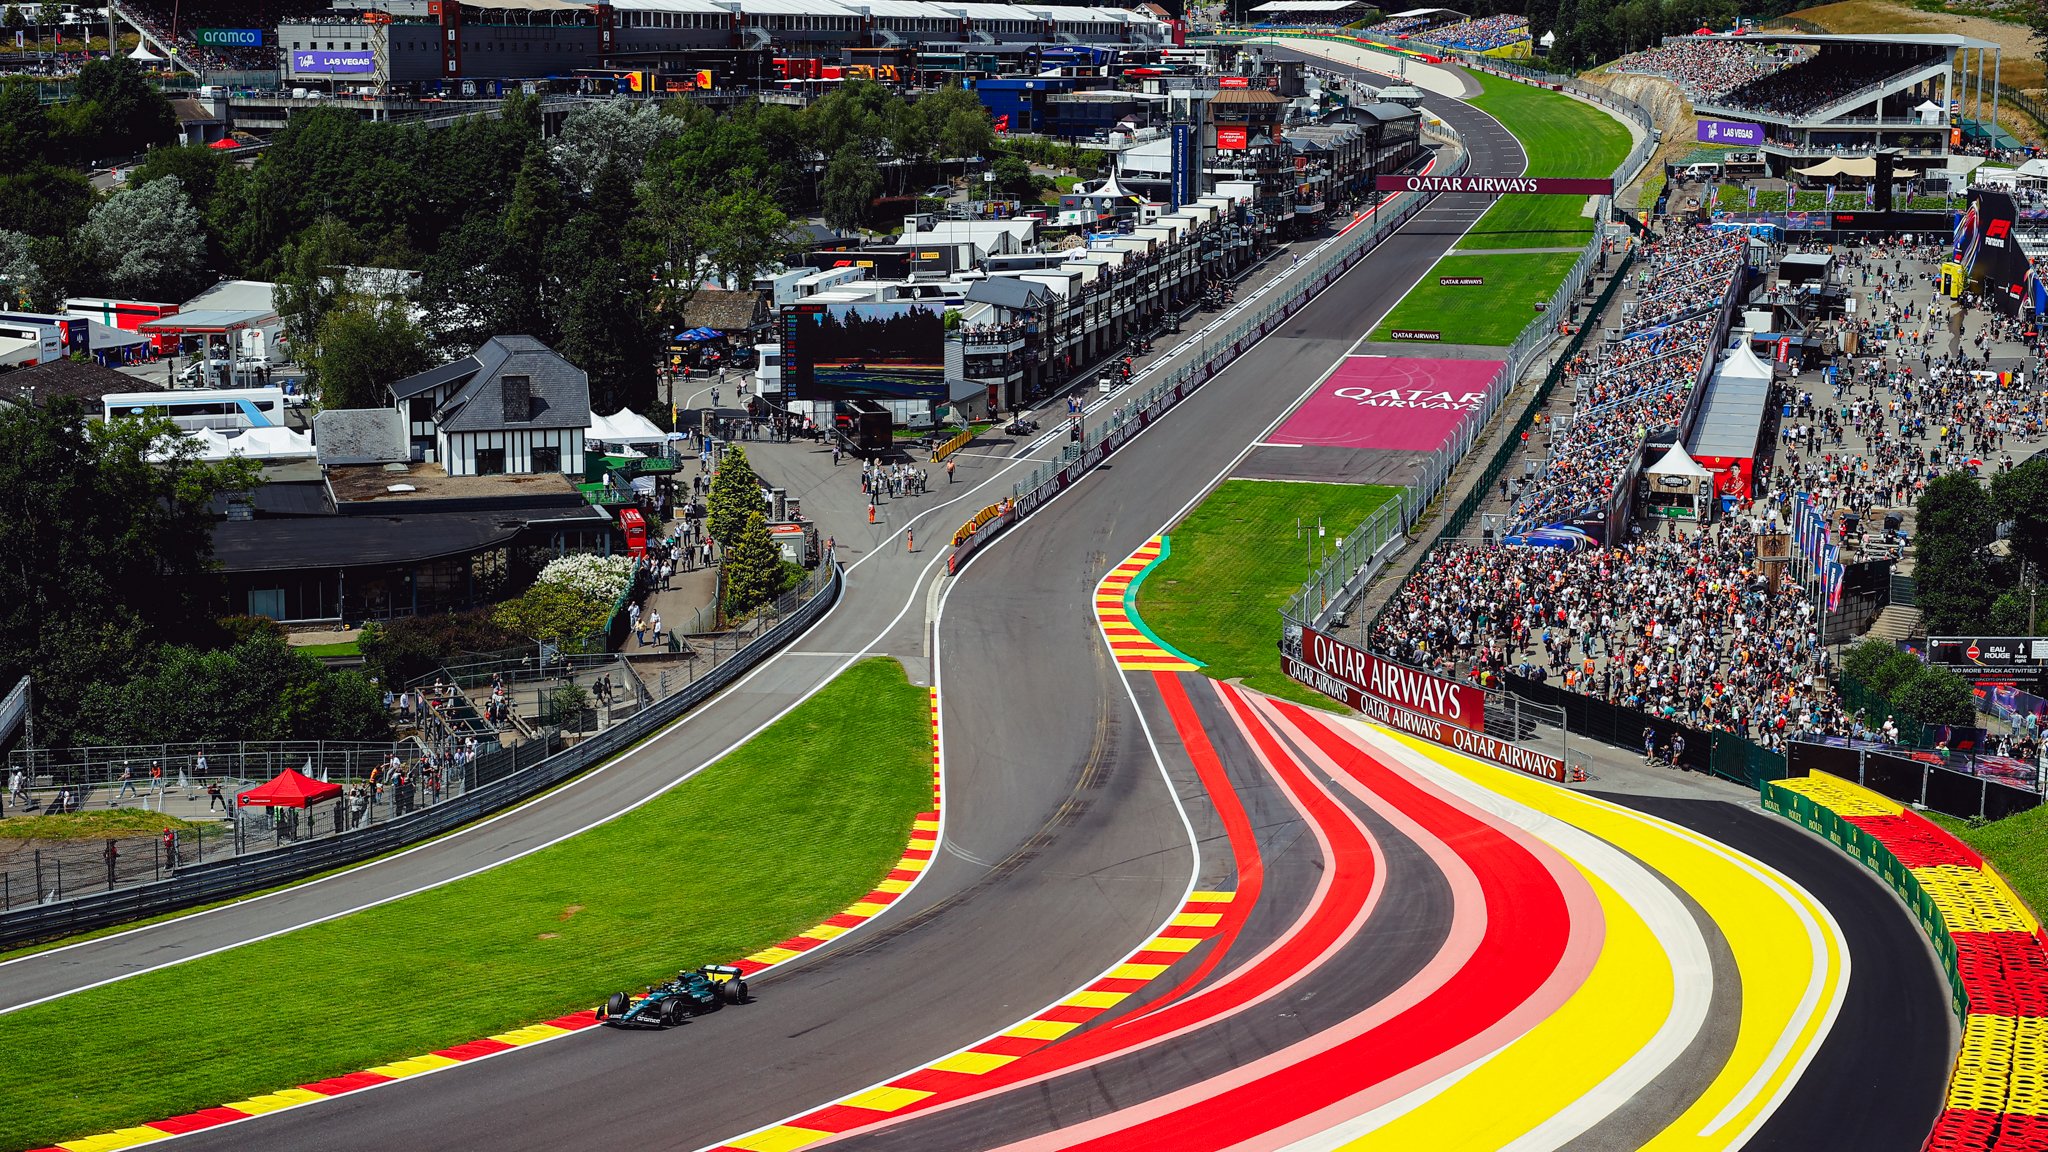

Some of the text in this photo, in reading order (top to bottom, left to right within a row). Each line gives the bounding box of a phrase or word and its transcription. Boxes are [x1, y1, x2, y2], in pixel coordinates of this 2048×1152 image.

[204, 31, 255, 43] aramco
[1723, 128, 1734, 138] LAS
[1735, 128, 1754, 139] VEGAS
[1406, 177, 1538, 192] QATAR AIRWAYS
[1146, 390, 1176, 422] QATAR AIRWAYS
[1334, 387, 1486, 412] QATAR AIRWAYS
[1108, 415, 1142, 450] QATAR AIRWAYS
[1066, 444, 1103, 482] QATAR AIRWAYS
[1018, 476, 1060, 516] QATAR AIRWAYS
[1288, 660, 1348, 703] QATAR AIRWAYS
[1314, 635, 1462, 720] QATAR AIRWAYS
[1361, 695, 1441, 742] QATAR AIRWAYS
[1453, 729, 1557, 780] QATAR AIRWAYS
[1764, 800, 1780, 812] ROLEX
[1788, 809, 1802, 824] ROLEX
[1808, 820, 1823, 834] ROLEX
[1846, 842, 1860, 858] ROLEX
